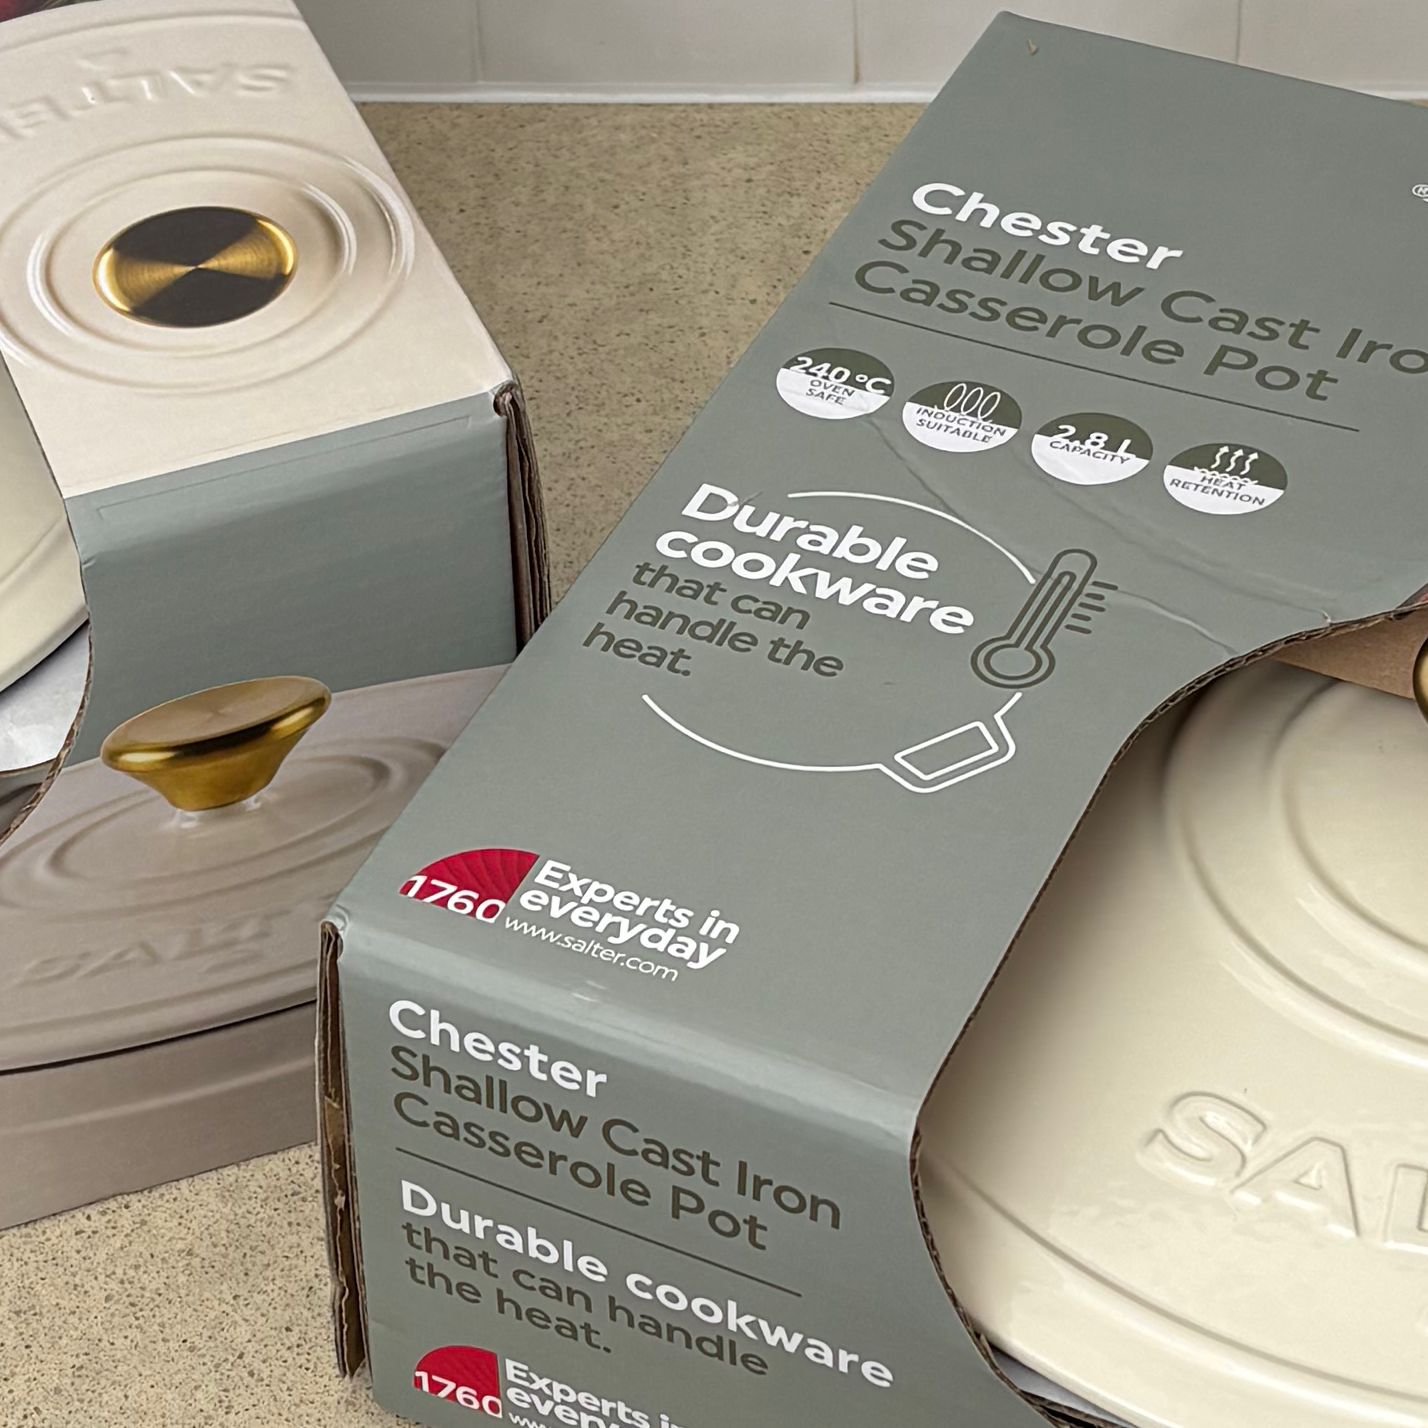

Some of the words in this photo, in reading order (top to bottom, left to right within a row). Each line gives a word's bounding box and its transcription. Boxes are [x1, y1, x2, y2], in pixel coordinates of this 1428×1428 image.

[912, 181, 1183, 270] Chester
[877, 218, 1145, 308] Shallow
[1160, 289, 1321, 352] Cast
[854, 260, 1186, 366] Casserole
[1203, 343, 1340, 402] Pot
[805, 387, 847, 406] SAFE
[810, 378, 855, 398] OVEN
[916, 406, 1007, 437] INDUCTION
[915, 417, 994, 443] SUITABLE
[1049, 440, 1130, 465] CAPACITY
[1052, 424, 1109, 452] 2.8
[1169, 478, 1266, 506] RETENTION
[1200, 475, 1247, 491] HEAT
[681, 482, 939, 580] Durable
[631, 561, 728, 607] that
[730, 593, 812, 630] can
[655, 530, 974, 635] cookware
[581, 622, 693, 677] heat.
[605, 589, 759, 654] handle
[766, 636, 845, 678] the
[405, 875, 508, 924] 1760
[519, 888, 727, 970] everyday
[533, 859, 695, 928] Experts
[698, 909, 741, 945] in
[504, 916, 680, 982] www.salter.com
[388, 999, 608, 1098] Chester
[389, 1044, 589, 1139] Shallow
[602, 1118, 722, 1188] Cast
[737, 1160, 841, 1230] Iron
[393, 1091, 652, 1207] Casserole
[671, 1185, 768, 1251] Pot
[400, 1178, 608, 1283] Durable
[625, 1272, 894, 1389] cookware
[401, 1221, 499, 1279] that
[512, 1268, 593, 1314] can
[608, 1294, 770, 1376] handle
[404, 1257, 483, 1305] the
[497, 1288, 612, 1354] heat.
[414, 1371, 503, 1419] 1760
